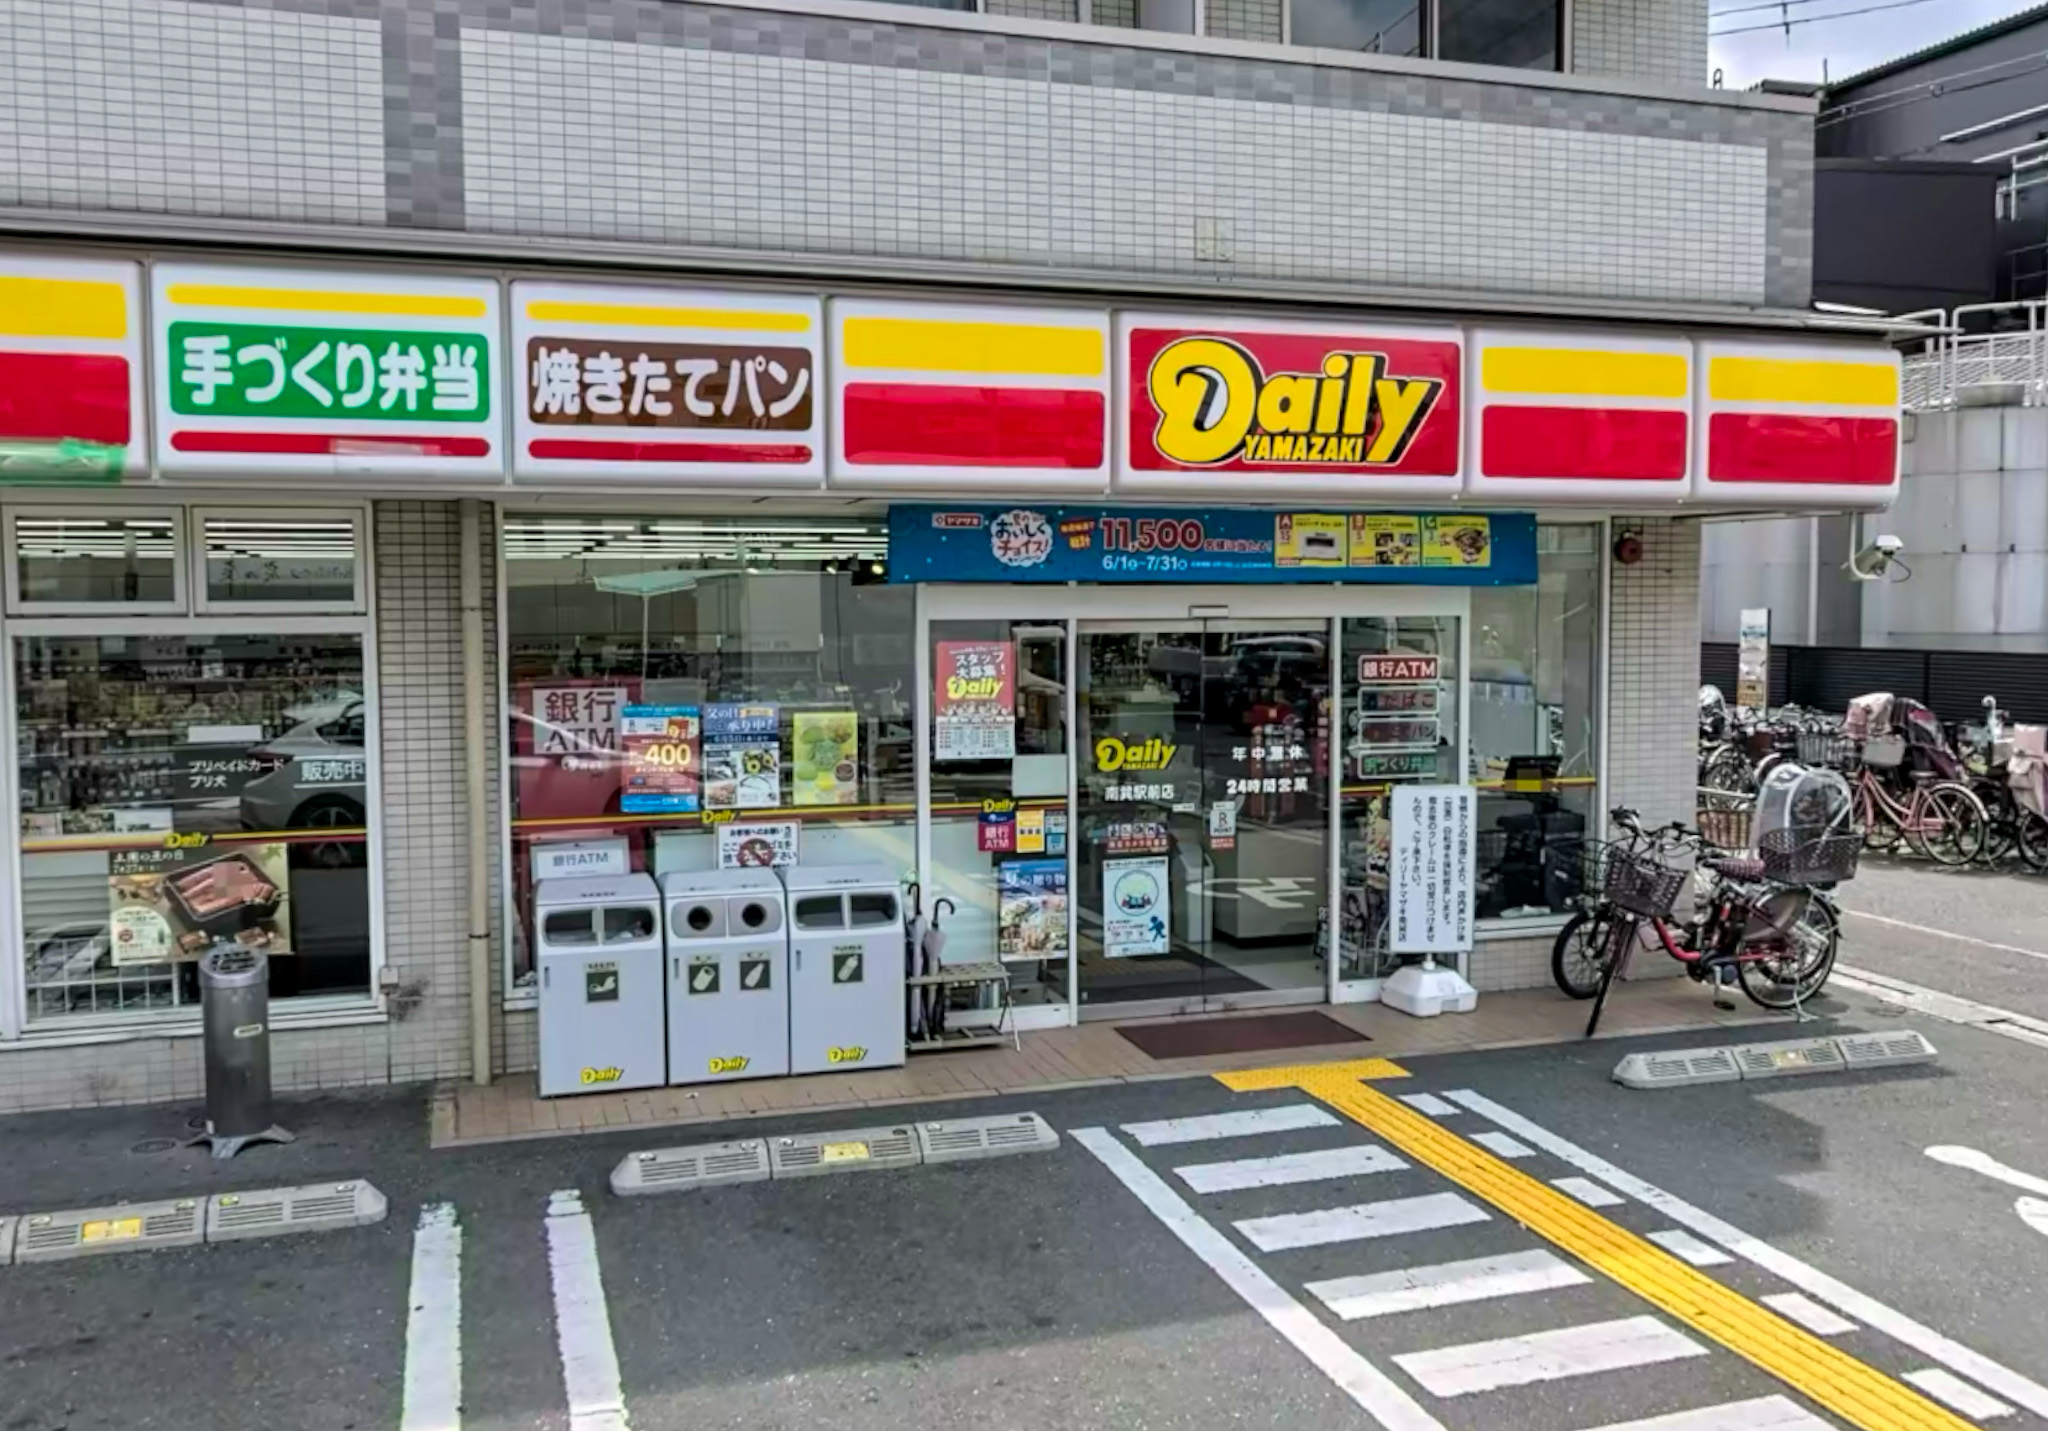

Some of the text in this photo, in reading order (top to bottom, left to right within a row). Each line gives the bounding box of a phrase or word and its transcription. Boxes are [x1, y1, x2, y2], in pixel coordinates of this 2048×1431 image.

[182, 335, 479, 411] 手づくり弁当
[531, 346, 809, 418] 焼きたてパン
[1149, 336, 1443, 466] Daily
[1244, 433, 1363, 462] YAMAZAKI
[995, 518, 1046, 540] おいしく
[1101, 518, 1205, 552] 11,500
[996, 539, 1049, 557] チョイス!
[1363, 661, 1436, 678] 銀行ATM
[946, 676, 1004, 699] Daily
[545, 691, 617, 723] 銀行
[546, 727, 615, 752] ATM
[644, 743, 691, 765] 400
[1095, 738, 1177, 773] Daily
[1232, 746, 1304, 762] 年中無休
[188, 759, 284, 775] プリペイドカード
[301, 761, 364, 781] 販売中
[1226, 777, 1309, 794] 24時間営業
[982, 798, 1016, 812] Daily
[701, 810, 740, 823] Daily
[163, 832, 208, 849] Daily
[984, 826, 1009, 839] 銀行
[985, 839, 1009, 849] ATM
[552, 852, 609, 867] 銀行ATM
[709, 1055, 750, 1074] Daily
[827, 1046, 868, 1064] Daily
[580, 1066, 624, 1085] Daily
